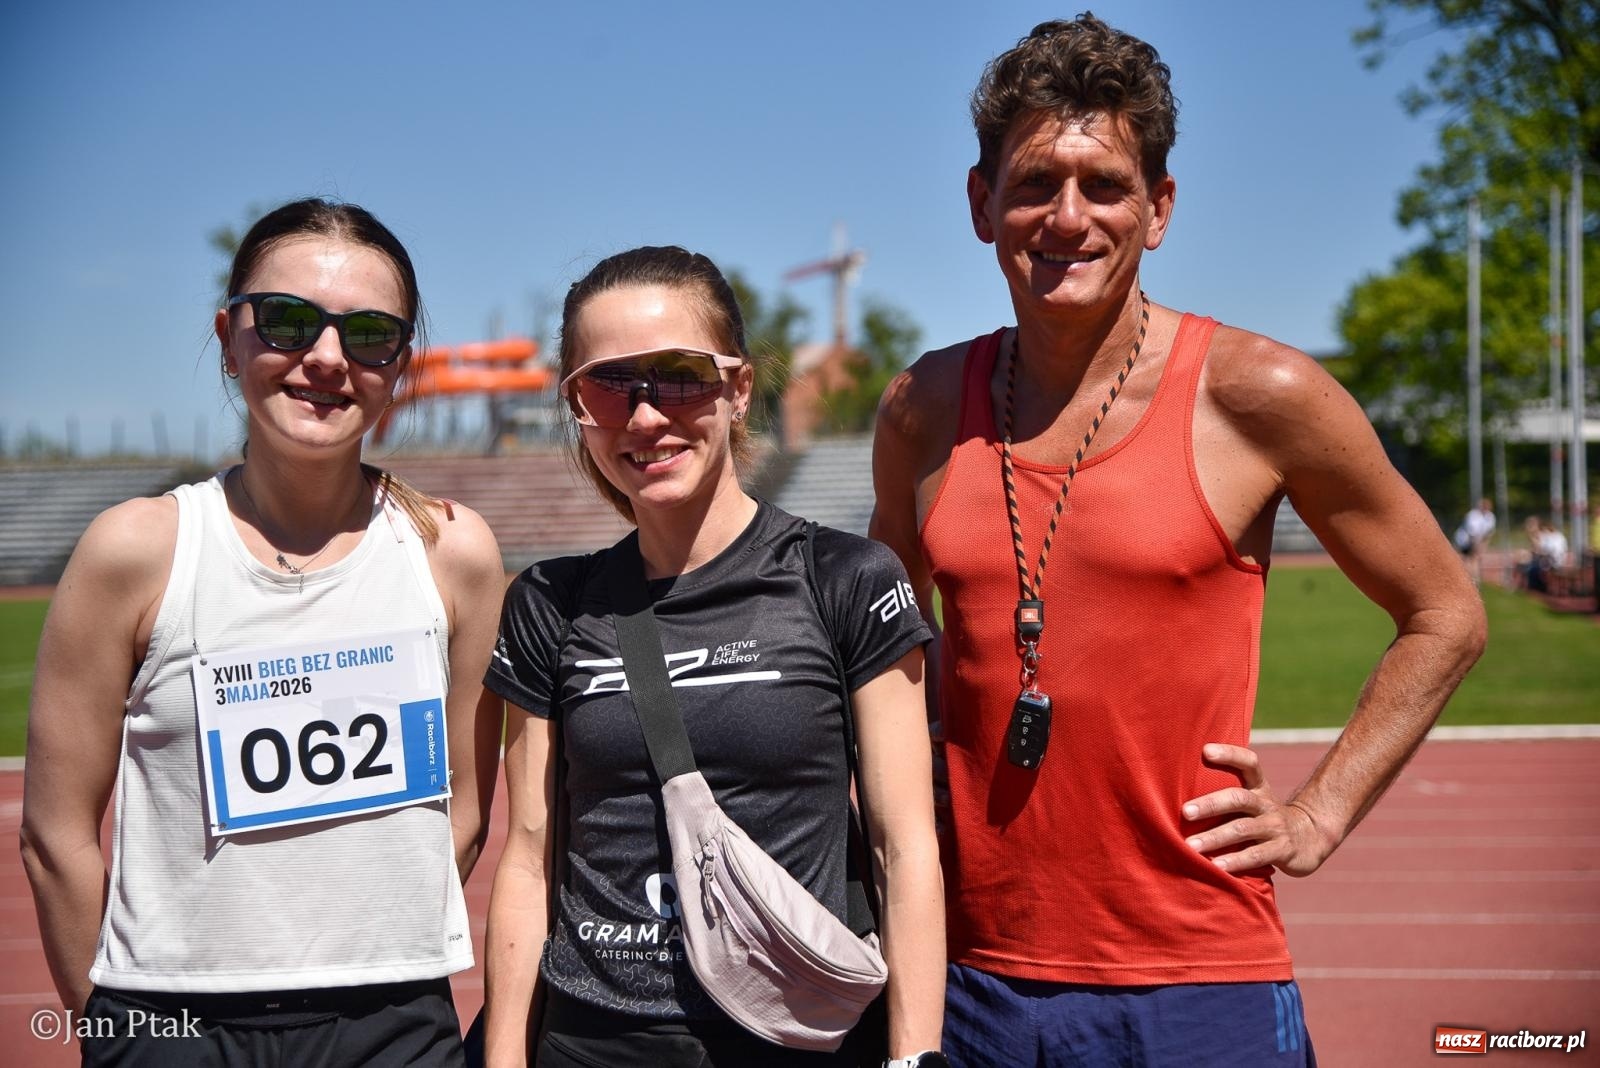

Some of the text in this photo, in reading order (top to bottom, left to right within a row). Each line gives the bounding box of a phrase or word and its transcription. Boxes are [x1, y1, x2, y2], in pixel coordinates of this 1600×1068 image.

[716, 639, 758, 653] ACTIVE
[711, 653, 760, 666] ENERGY
[713, 649, 740, 661] LIFE
[212, 645, 394, 685] XVIII BIEG BEZ GRANIC
[240, 713, 393, 794] 062
[594, 949, 654, 961] CATERING
